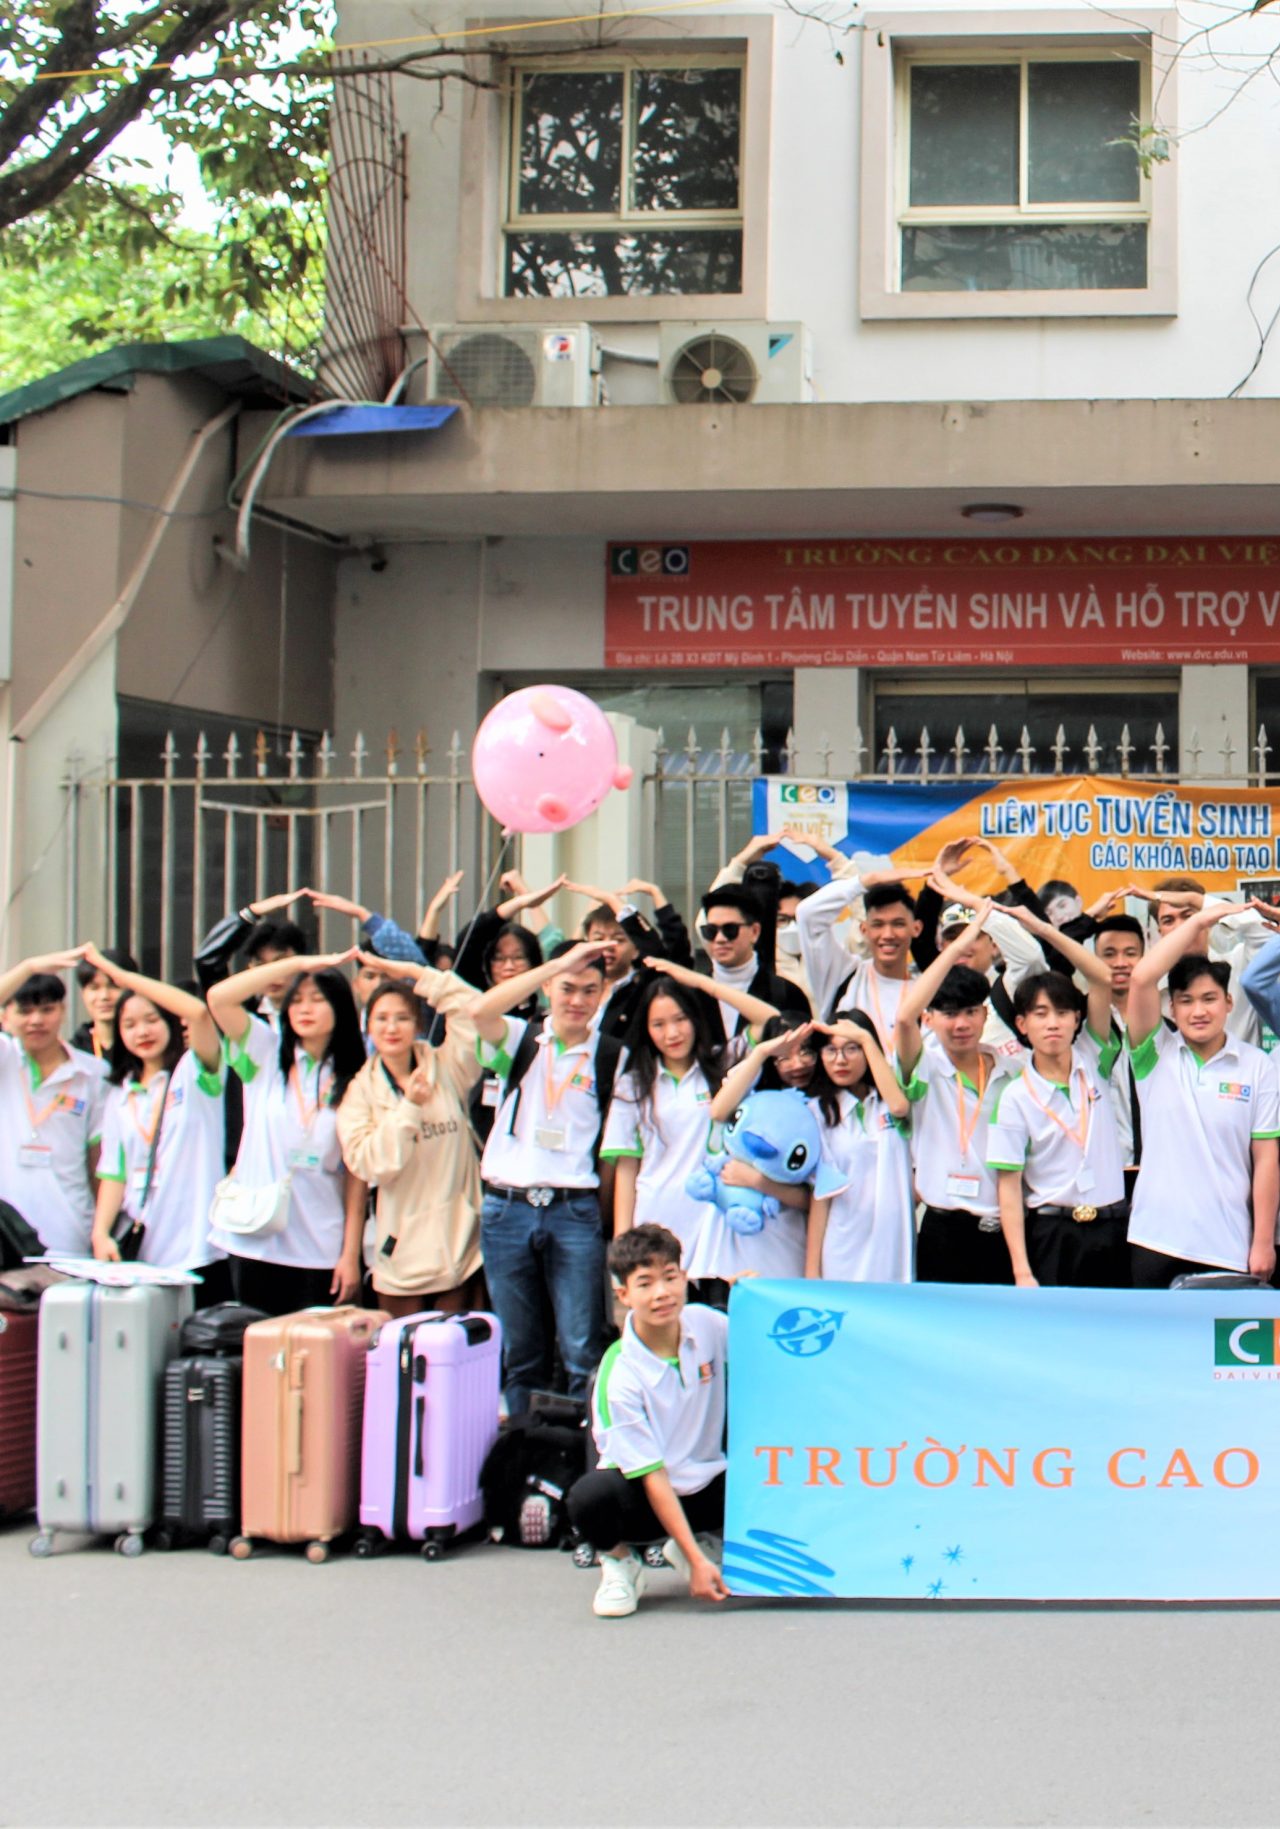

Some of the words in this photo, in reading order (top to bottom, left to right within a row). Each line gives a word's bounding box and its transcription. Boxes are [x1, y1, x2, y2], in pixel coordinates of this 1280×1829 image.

[943, 547, 1021, 563] CAO
[637, 595, 754, 632] TRUNG
[764, 586, 835, 630] TÂM
[846, 584, 957, 630] TUYỂN
[969, 592, 1048, 629] SINH
[1058, 584, 1105, 628] VÀ
[1116, 583, 1165, 628] HỖ
[1175, 591, 1249, 636] TRỢ
[1120, 648, 1165, 661] Website:
[983, 798, 1036, 835] LIÊN
[1043, 802, 1089, 839] TỤC
[1096, 792, 1190, 836] TUYỂN
[1200, 804, 1269, 836] SINH
[1092, 839, 1128, 868] CÁC
[1134, 840, 1185, 869] KHÓA
[1191, 841, 1229, 869] ĐÀO
[1234, 846, 1270, 873] TẠO
[756, 1438, 1074, 1489] TRƯỜNG
[1108, 1448, 1260, 1489] CAO
